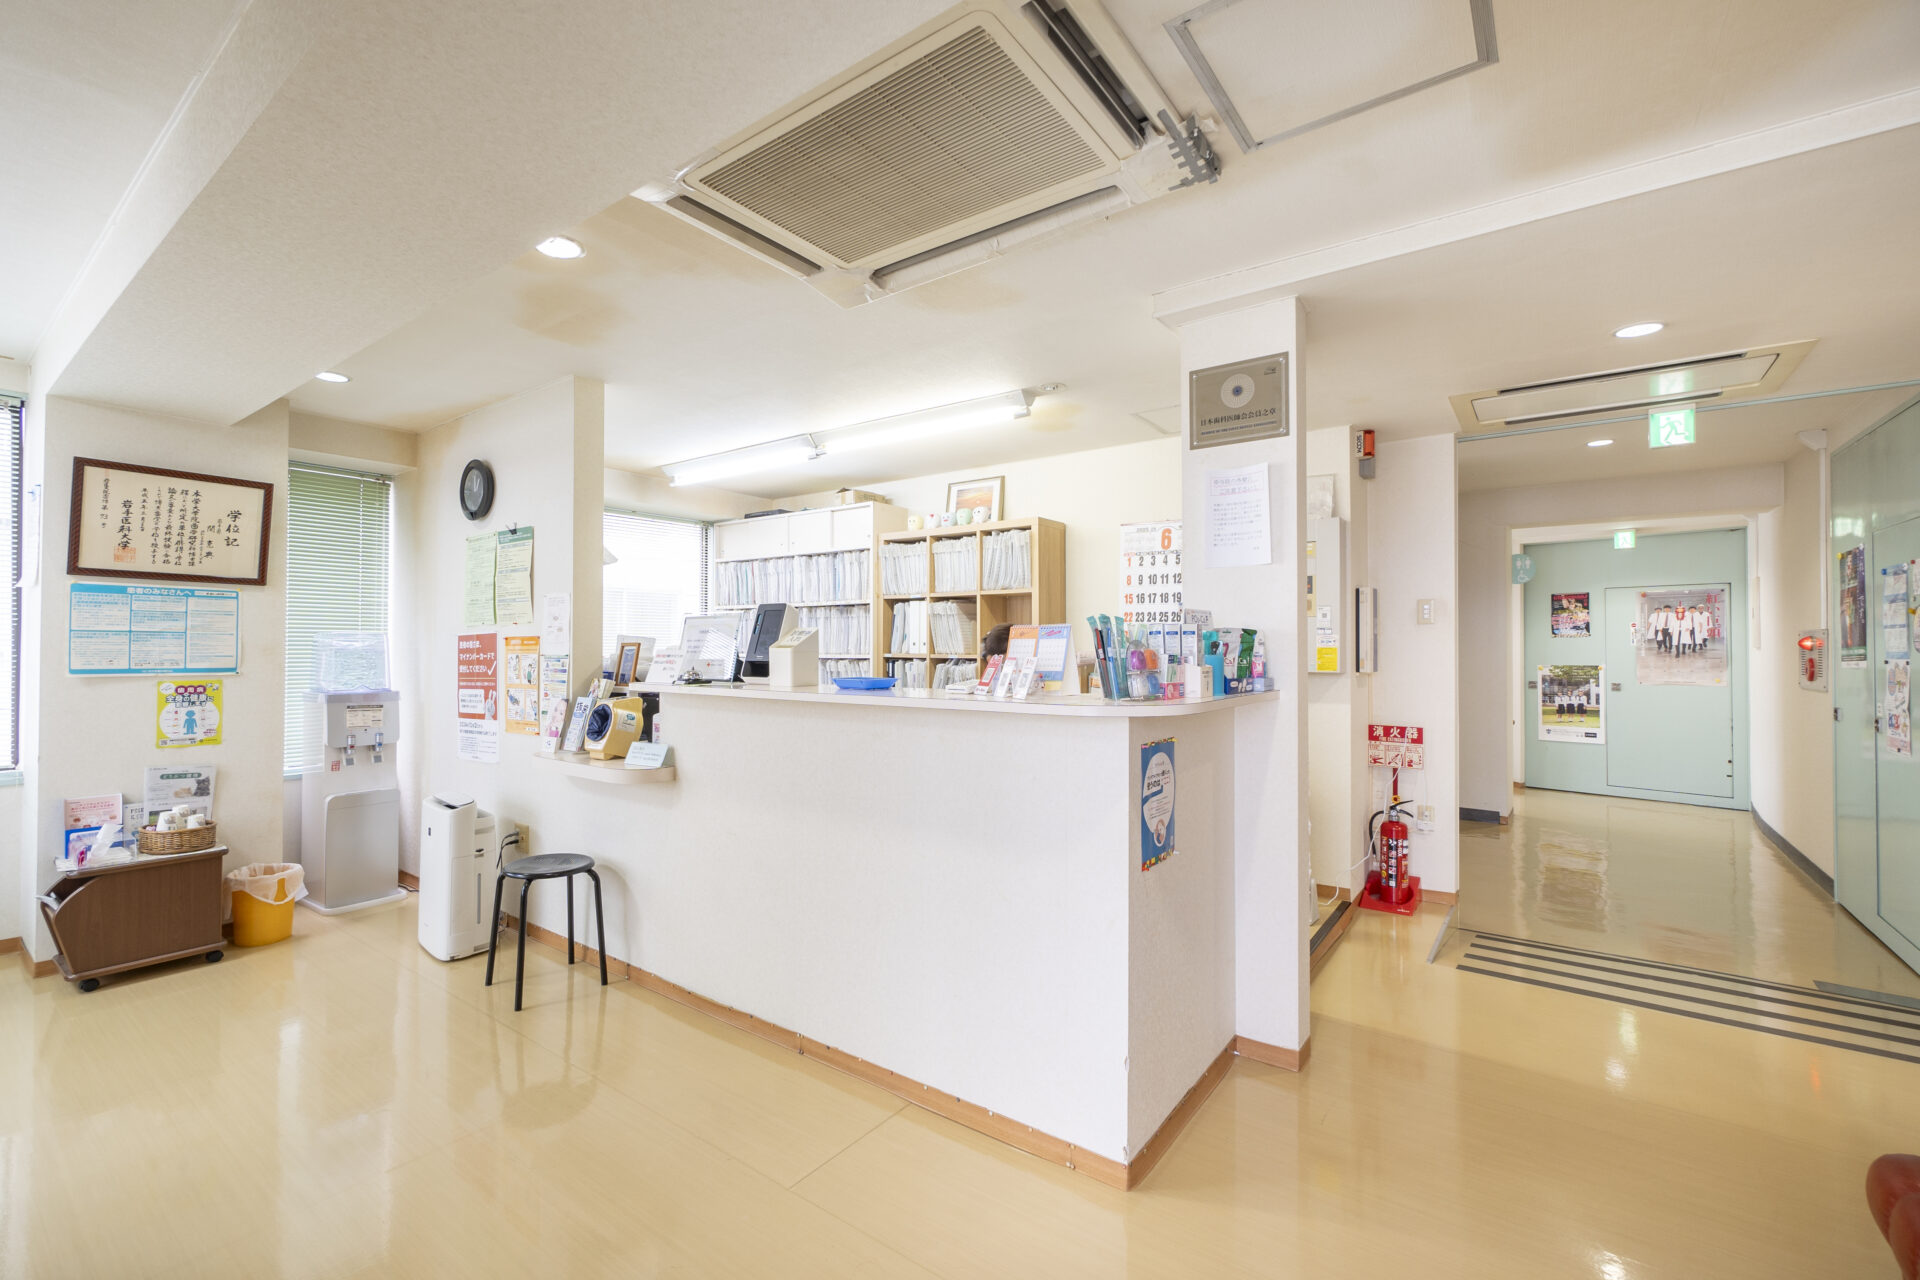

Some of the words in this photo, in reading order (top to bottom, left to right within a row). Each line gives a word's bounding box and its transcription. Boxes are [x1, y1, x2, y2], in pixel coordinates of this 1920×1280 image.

[224, 510, 242, 547] 学位記
[1161, 528, 1172, 550] 6
[1128, 557, 1131, 568] 1
[1139, 556, 1144, 566] 2
[1151, 555, 1156, 566] 3
[1163, 555, 1168, 565] 4
[1175, 554, 1181, 565] 5
[1127, 575, 1131, 586] 8
[1138, 574, 1143, 585] 9
[1148, 574, 1157, 584] 10
[1160, 573, 1169, 584] 11
[1173, 573, 1182, 584] 12
[1125, 593, 1133, 604] 15
[1136, 593, 1145, 603] 16
[1148, 593, 1157, 603] 17
[1160, 592, 1169, 603] 18
[1172, 592, 1181, 603] 19
[1124, 612, 1133, 622] 22
[1135, 612, 1144, 622] 23
[1147, 612, 1157, 622] 24
[1159, 612, 1168, 622] 25
[1171, 612, 1181, 622] 26
[1373, 725, 1419, 739] 消火器
